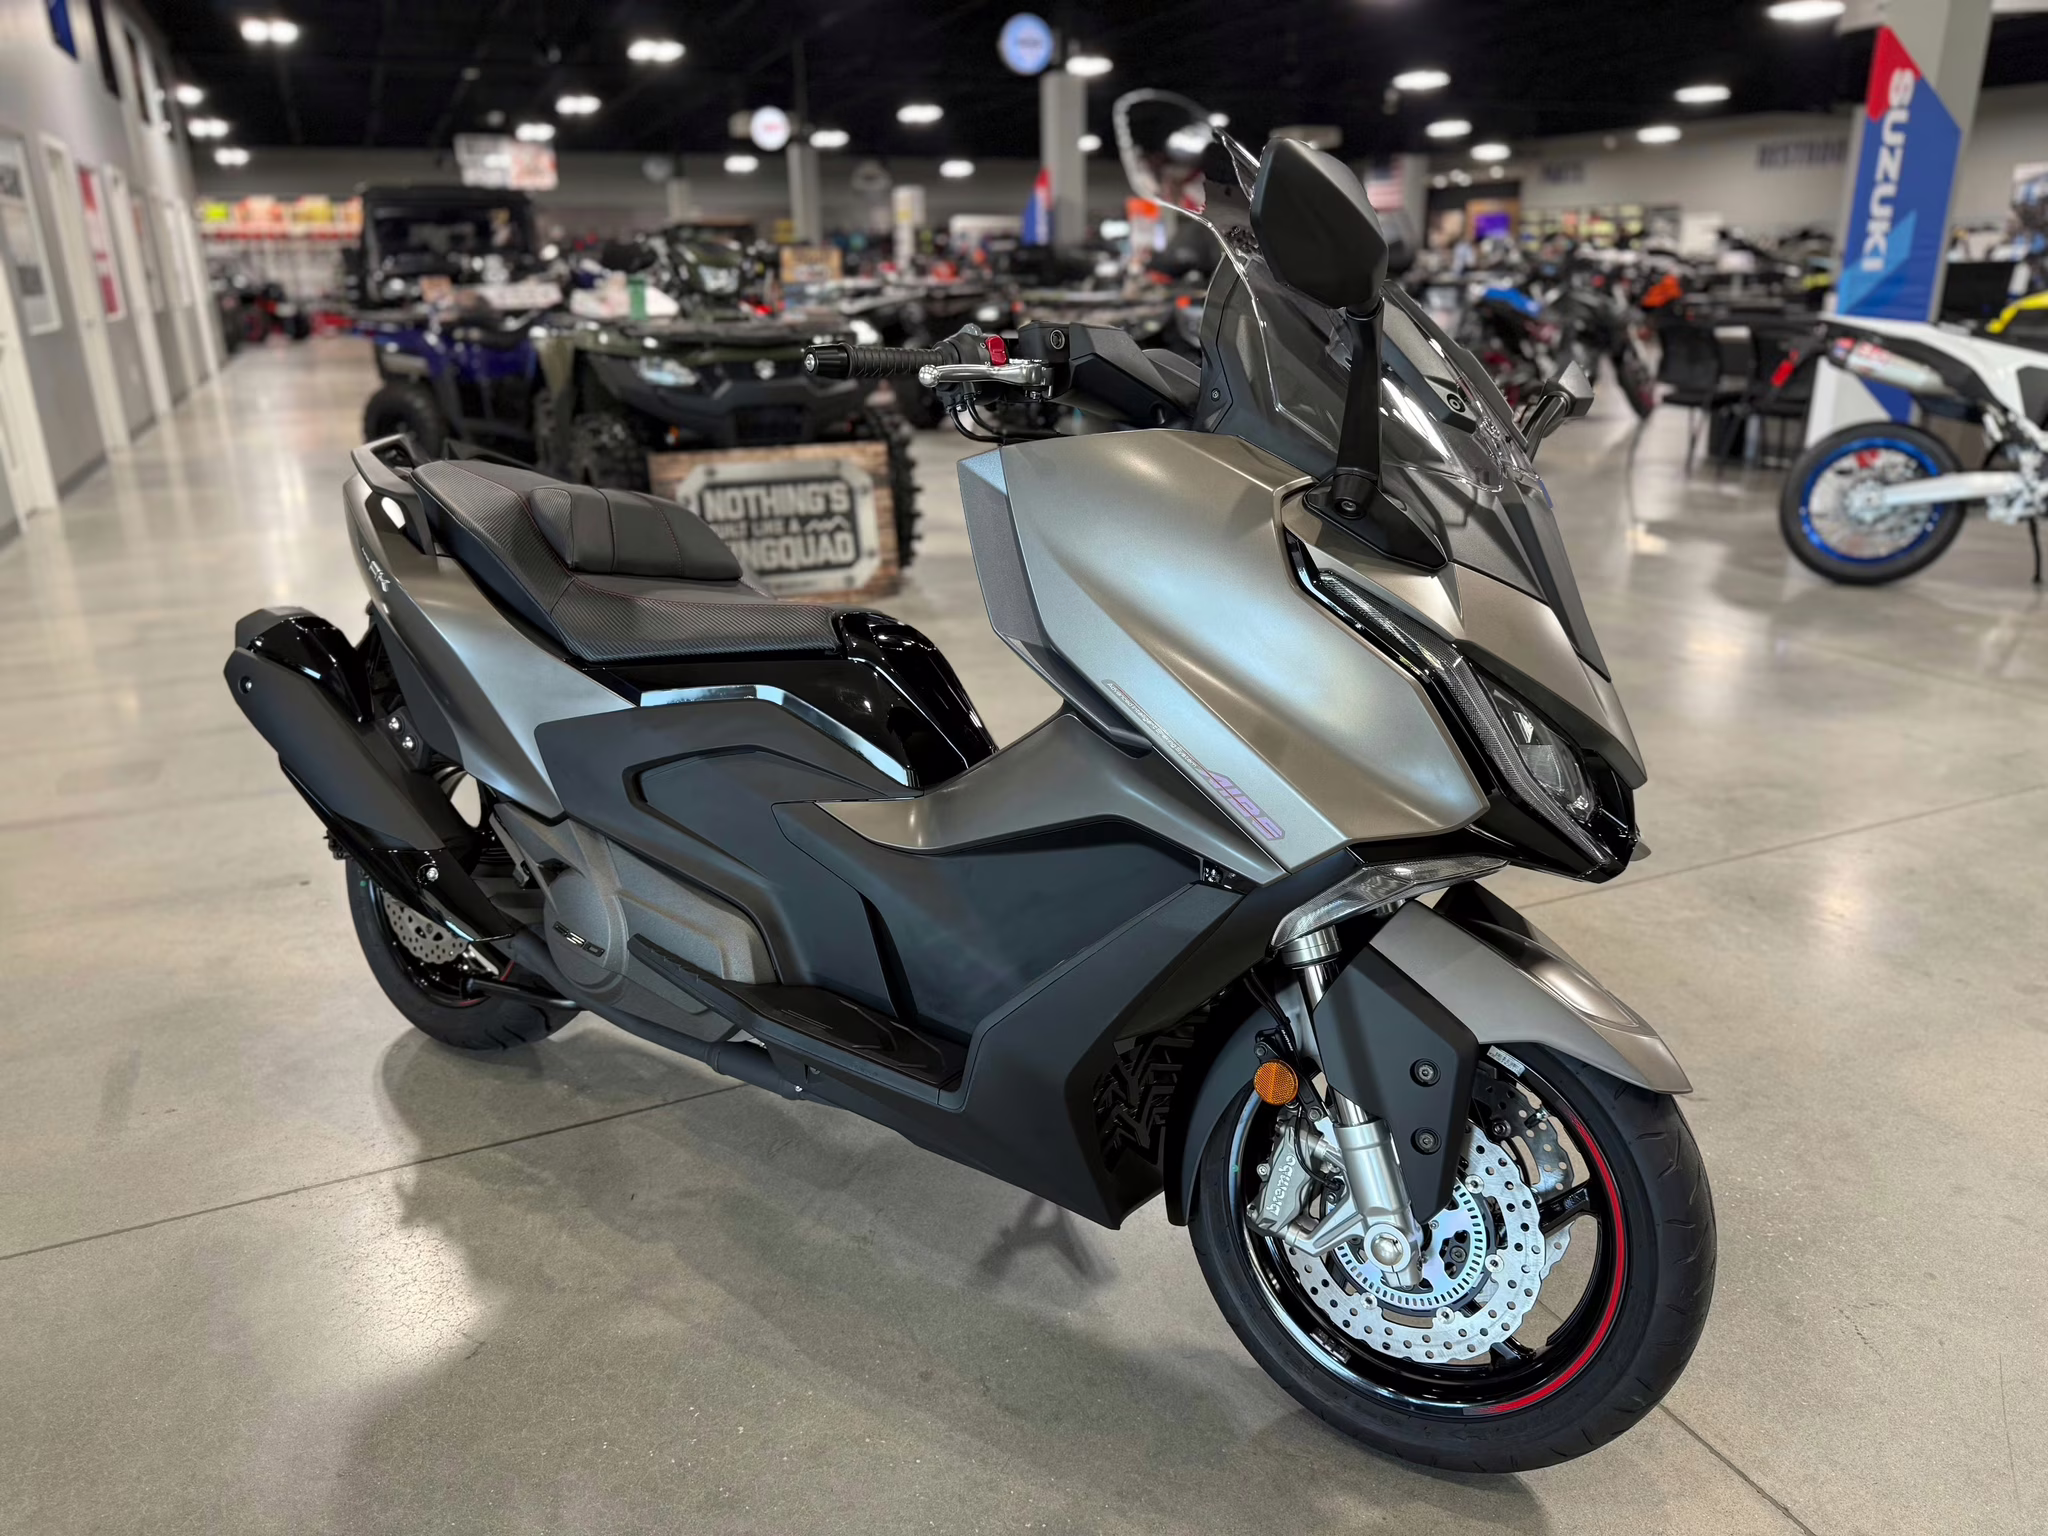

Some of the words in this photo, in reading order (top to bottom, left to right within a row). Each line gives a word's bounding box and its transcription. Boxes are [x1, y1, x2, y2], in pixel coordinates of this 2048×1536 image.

[1861, 68, 1915, 271] SUZUKI
[705, 482, 849, 521] NOTHING'S
[787, 517, 800, 534] A
[725, 531, 856, 570] NGQUAD
[1107, 683, 1133, 707] Advanced
[1175, 746, 1198, 768] System
[1266, 1155, 1296, 1216] brembo
